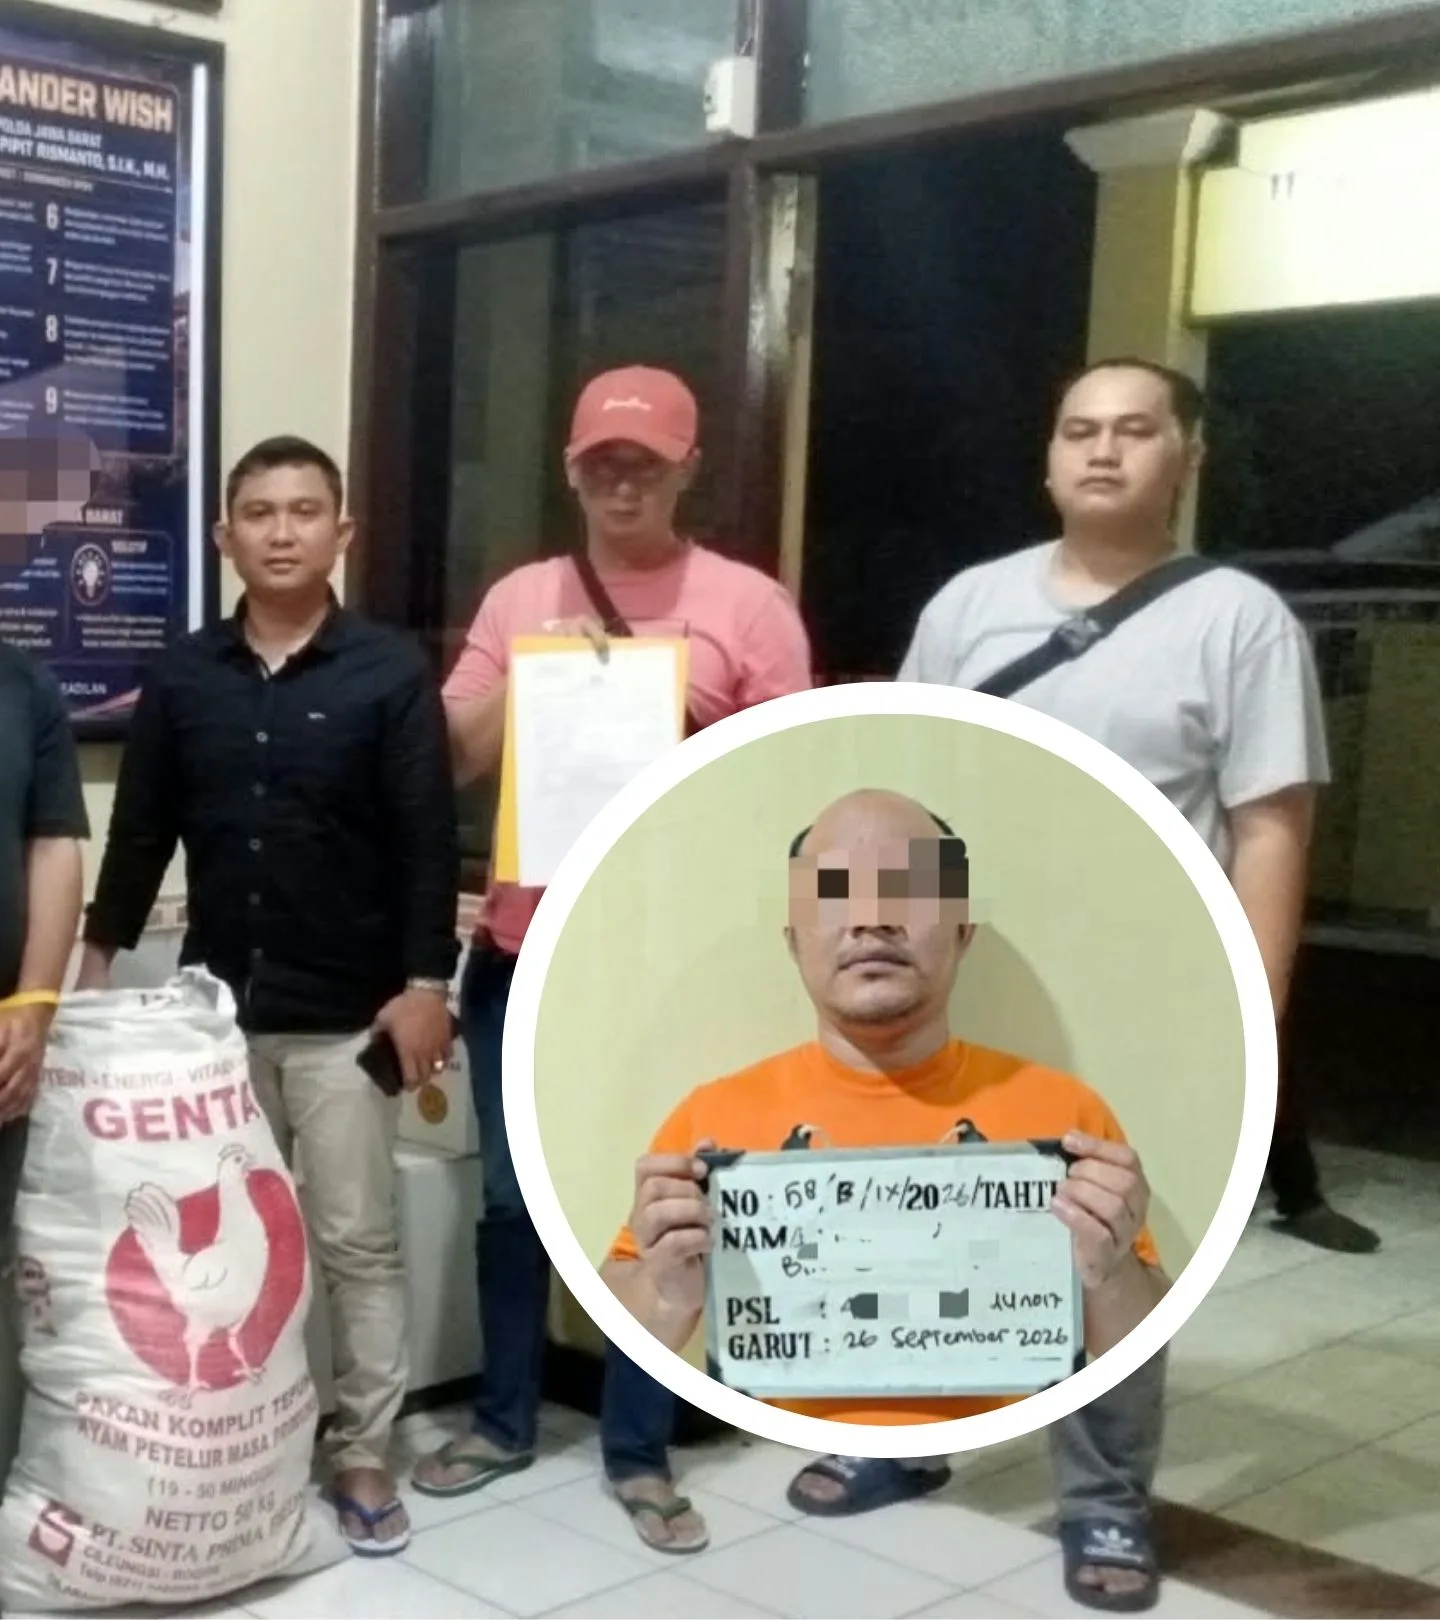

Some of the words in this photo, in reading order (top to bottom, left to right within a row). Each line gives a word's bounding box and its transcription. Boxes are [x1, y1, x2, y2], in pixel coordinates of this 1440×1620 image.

[103, 84, 173, 133] WISH
[0, 136, 34, 157] PIPIT
[46, 203, 58, 230] 6
[46, 257, 58, 285] 7
[46, 314, 58, 342] 8
[721, 1188, 759, 1219] NO
[727, 1296, 780, 1326] PSL
[728, 1332, 812, 1361] GARUT
[1017, 1326, 1068, 1347] 2026
[75, 1391, 160, 1431] PAKAN
[168, 1404, 265, 1438] KOMPLIT
[78, 1416, 129, 1453] AYAM
[135, 1434, 224, 1468] PETELUR
[228, 1434, 270, 1464] MASA
[145, 1505, 228, 1533] NETTO
[129, 1536, 200, 1563] SINTA
